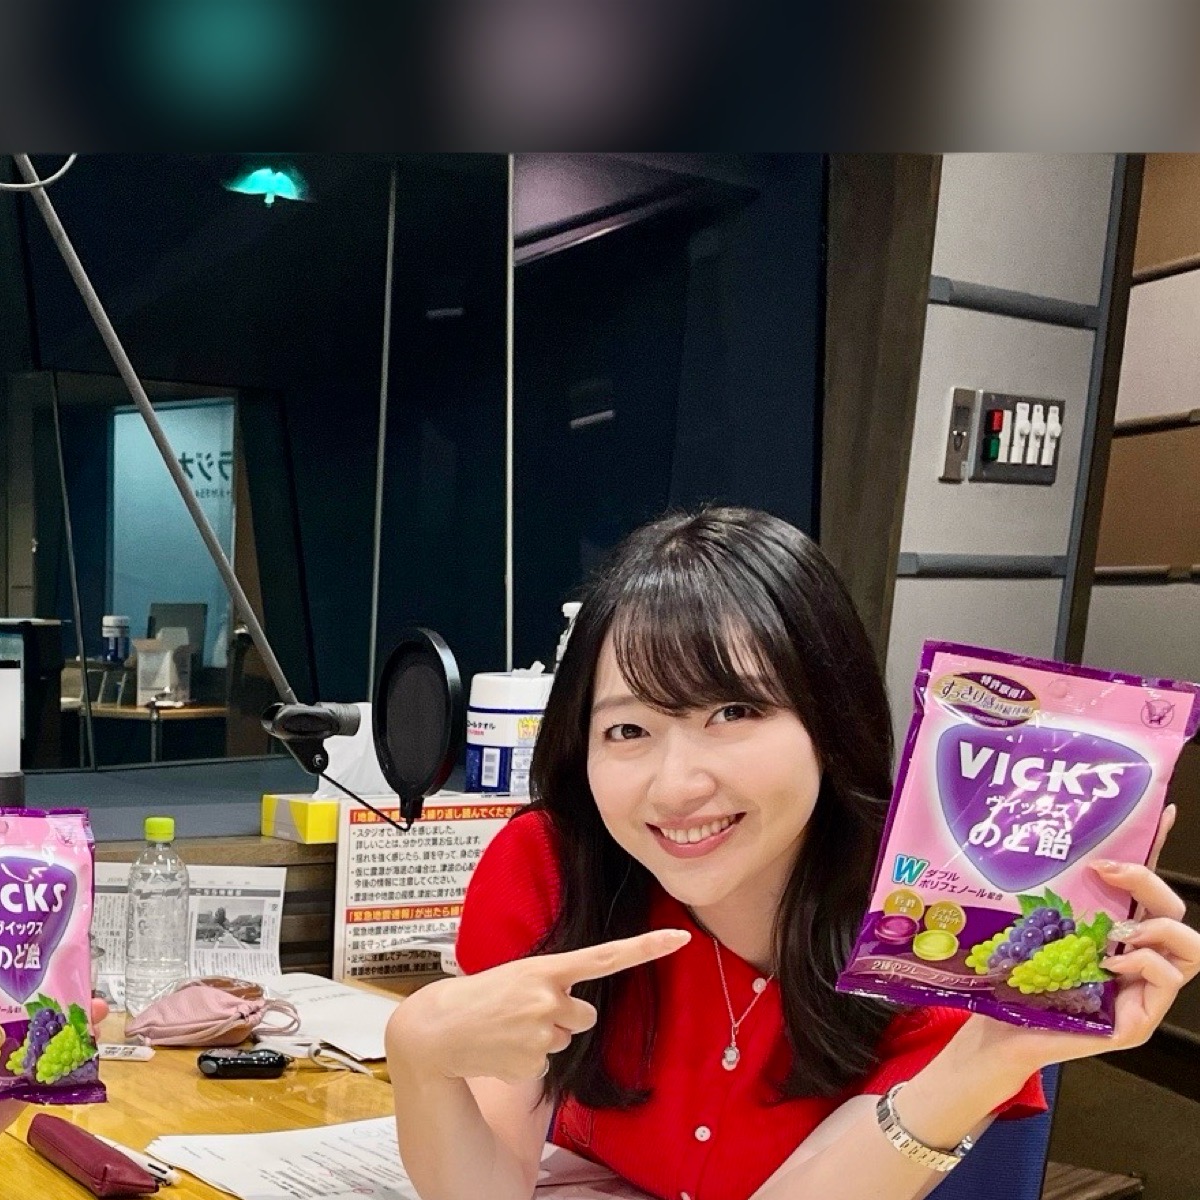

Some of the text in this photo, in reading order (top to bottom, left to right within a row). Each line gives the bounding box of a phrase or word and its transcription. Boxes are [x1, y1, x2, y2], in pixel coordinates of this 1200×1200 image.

[958, 740, 1124, 799] VICKS
[968, 820, 1073, 861] のど飴
[893, 853, 960, 886] W ダブル
